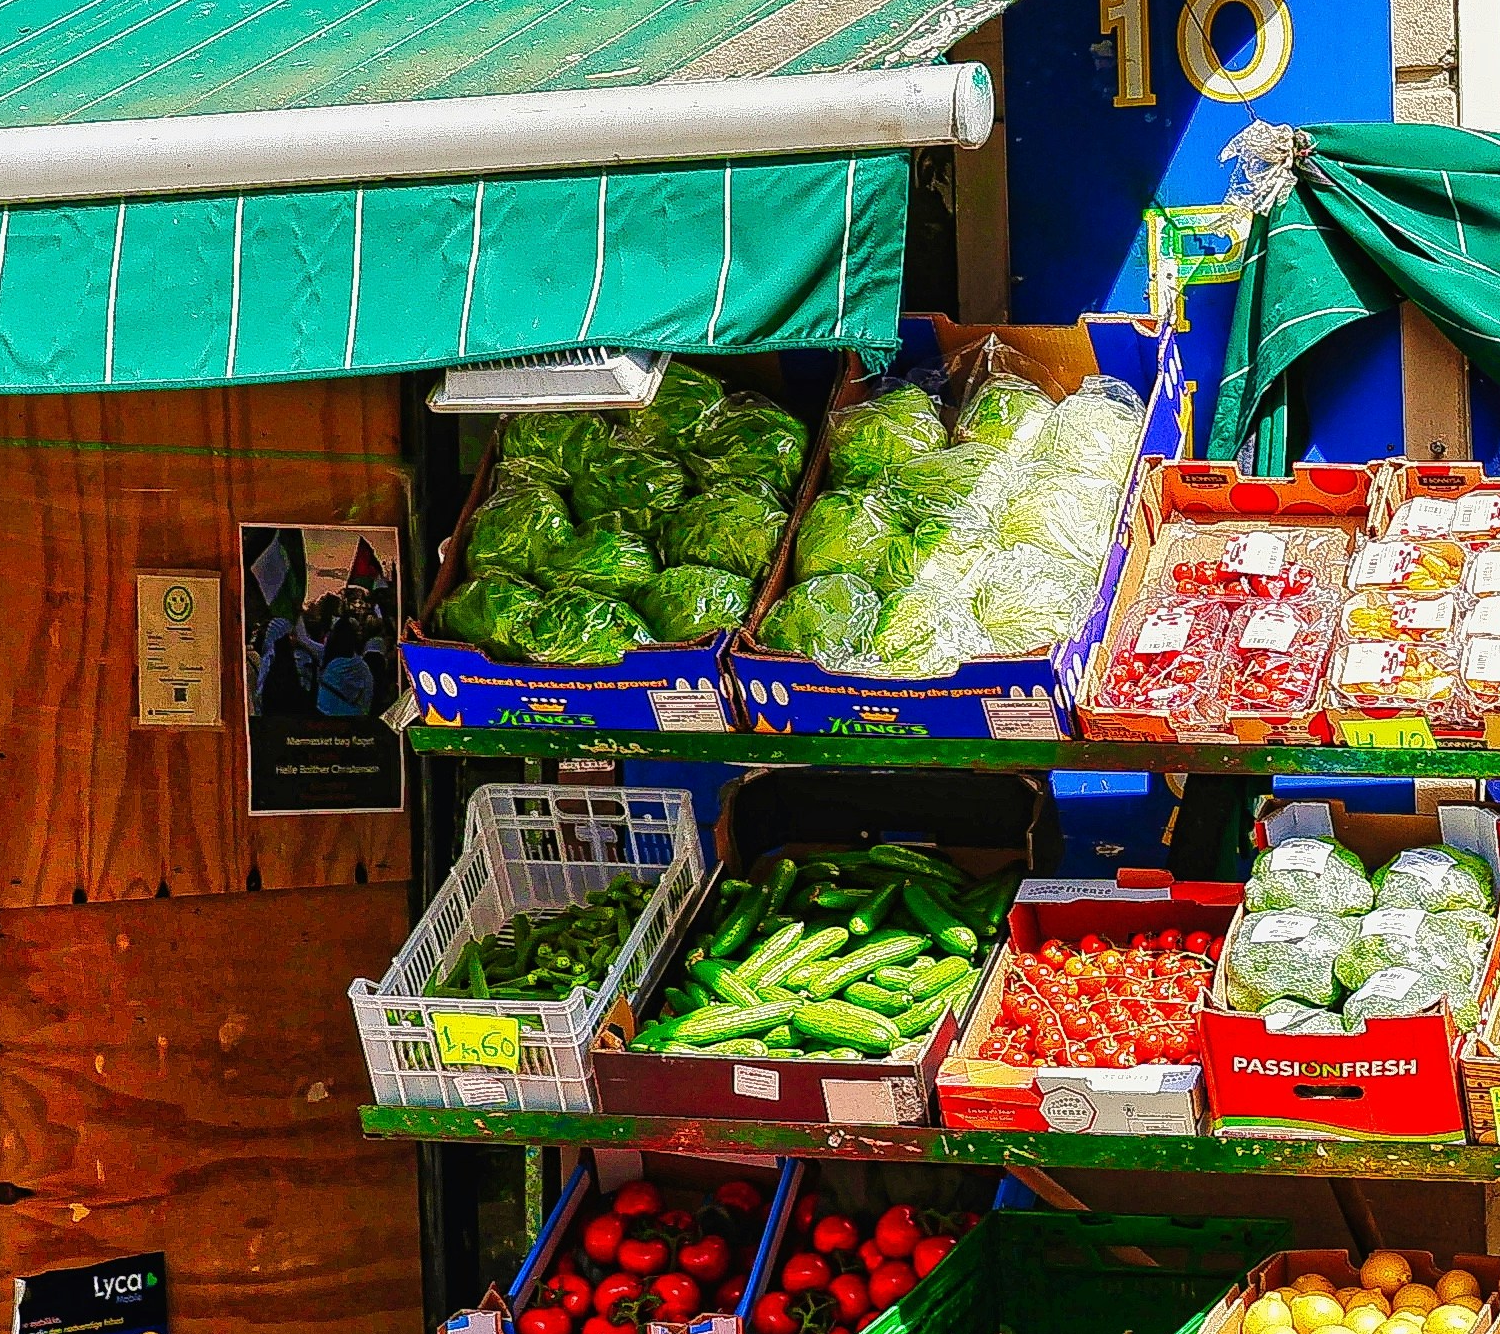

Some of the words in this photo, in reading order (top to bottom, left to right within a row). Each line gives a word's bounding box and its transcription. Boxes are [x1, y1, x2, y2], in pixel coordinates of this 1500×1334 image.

[495, 708, 597, 727] KING'S
[828, 717, 929, 737] KING'S
[1233, 1056, 1418, 1079] PASSIONFRESH
[93, 1271, 144, 1301] Lyca
